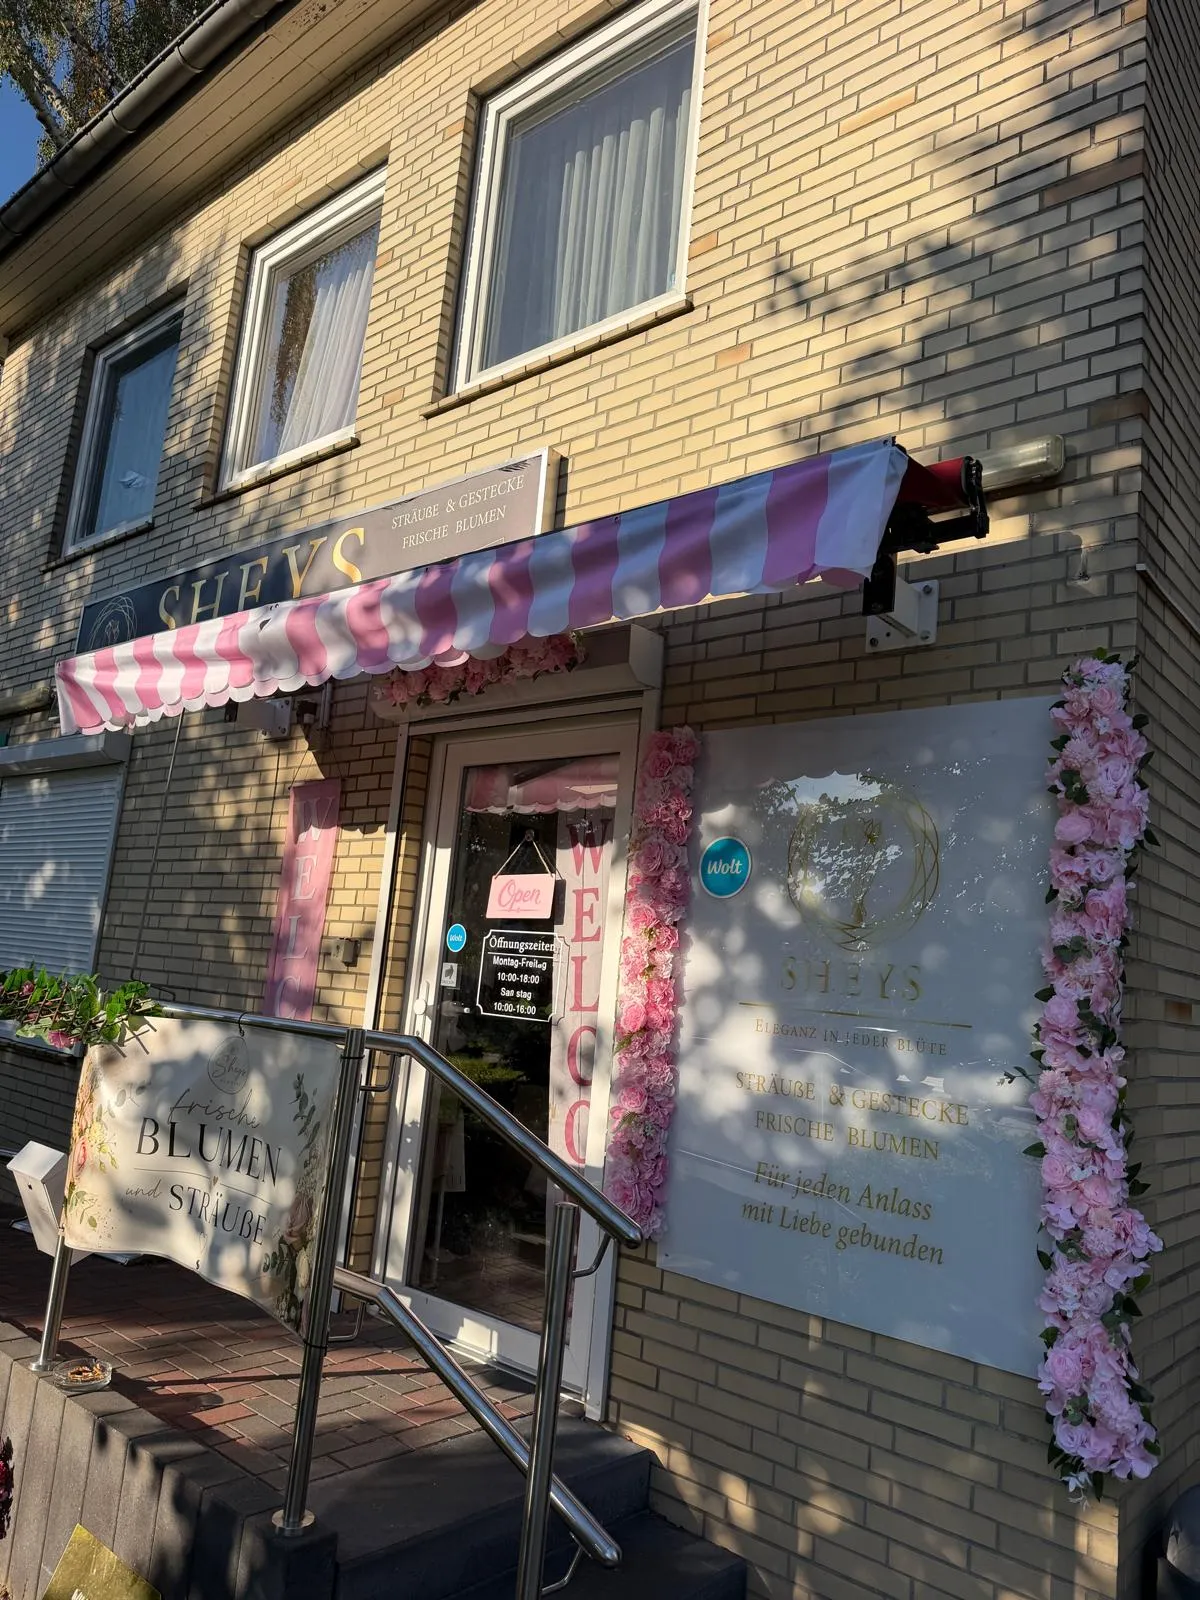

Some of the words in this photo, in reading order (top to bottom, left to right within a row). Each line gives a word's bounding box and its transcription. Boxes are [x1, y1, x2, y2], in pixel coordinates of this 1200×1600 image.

[445, 499, 456, 513] &
[459, 474, 525, 508] GESTECKE
[402, 524, 449, 549] FRISCHE
[455, 505, 507, 534] BLUMEN
[158, 527, 365, 630] SHEYS
[707, 858, 742, 875] Wolt
[499, 879, 541, 913] Open
[489, 935, 556, 953] Öffnungszeiten
[497, 971, 540, 984] 10:00-18:00
[781, 955, 922, 1001] SHEYS
[493, 1001, 537, 1015] 10:00-16:00
[828, 1085, 845, 1107] &
[852, 1088, 969, 1126] GESTECKE
[135, 1116, 283, 1188] BLUMEN
[755, 1110, 834, 1142] FRISCHE
[847, 1126, 940, 1161] BLUMEN
[125, 1178, 163, 1199] und
[754, 1161, 791, 1189] Für
[791, 1170, 850, 1204] jeden
[856, 1183, 933, 1221] Anlass
[741, 1200, 774, 1225] mit
[778, 1206, 833, 1239] Liebe
[835, 1222, 944, 1266] gebunden
